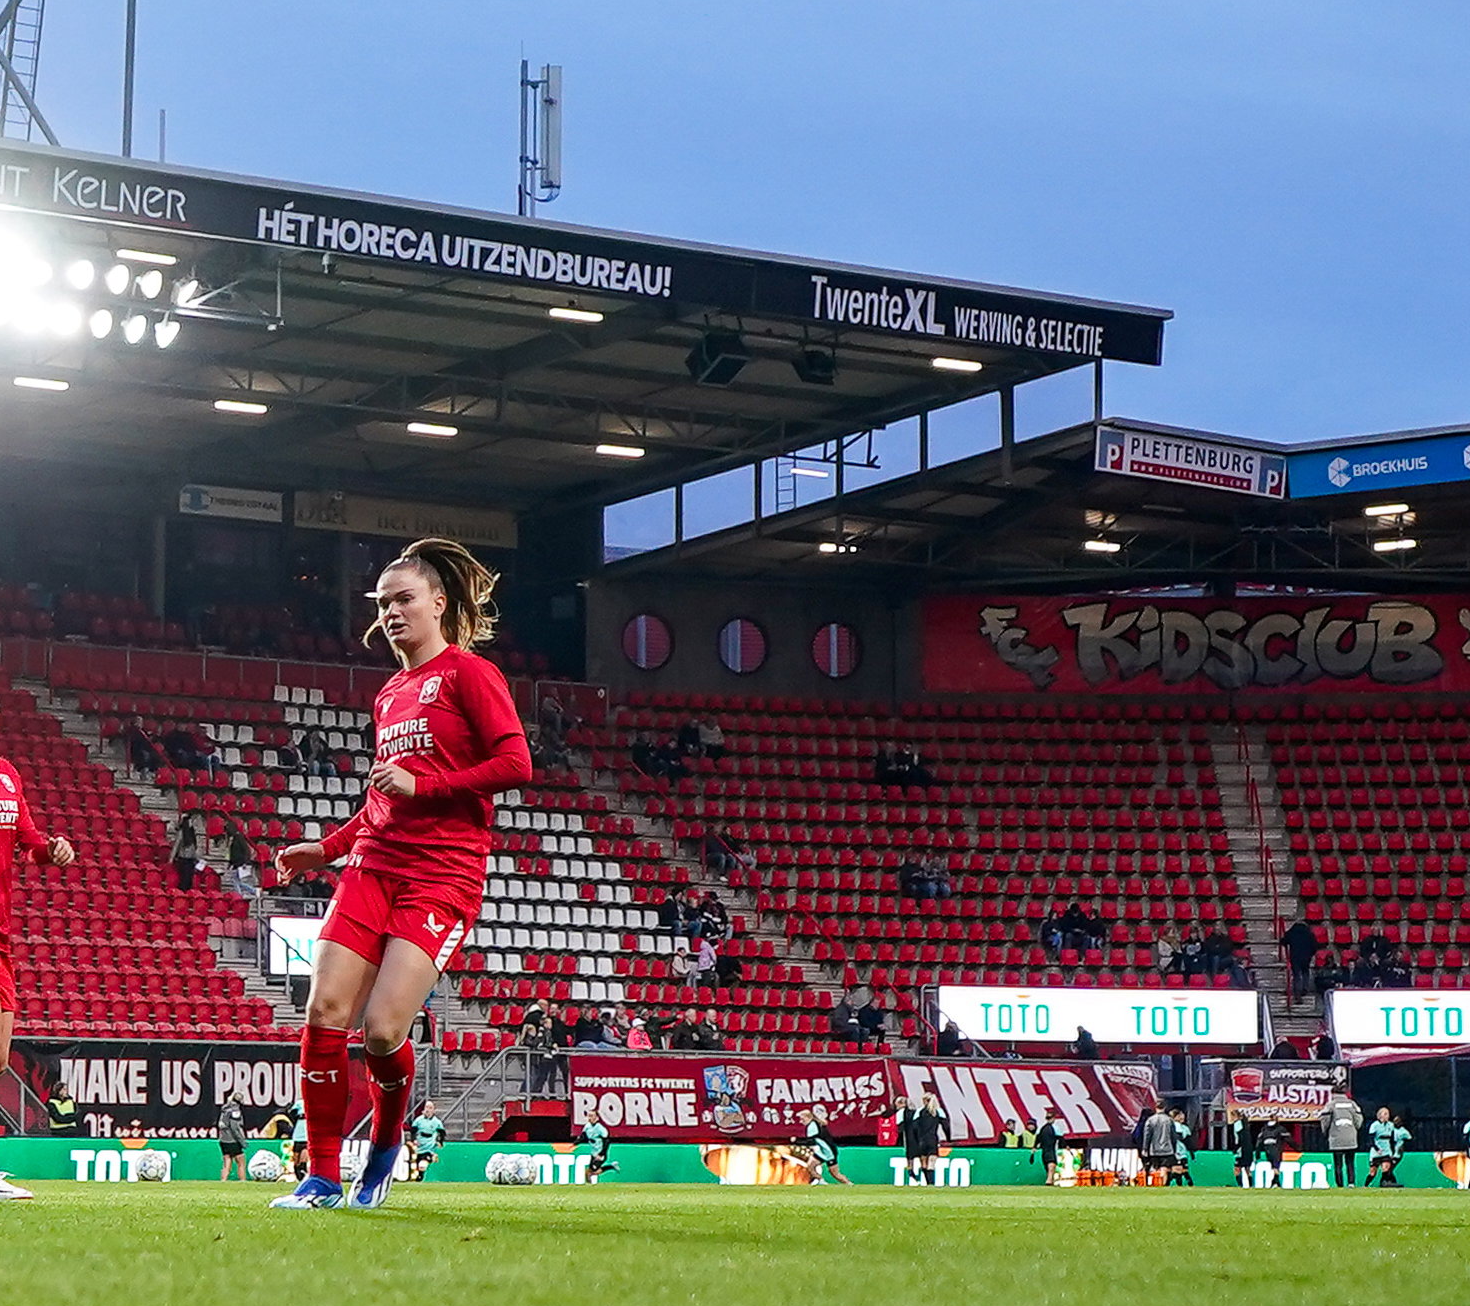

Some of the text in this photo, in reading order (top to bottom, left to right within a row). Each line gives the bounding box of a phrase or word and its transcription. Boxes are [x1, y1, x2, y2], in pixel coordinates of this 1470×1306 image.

[257, 200, 674, 298] HÉT HORECA UITZENDBUREAU!
[810, 273, 1104, 359] TwenteXL WERVING & SELECTIE
[1130, 437, 1254, 475] PLETTENBURG
[1352, 455, 1428, 479] BROEKHUIS
[378, 717, 429, 742] FUTURE
[980, 1002, 1050, 1035] TOTO
[1131, 1005, 1210, 1037] TOTO
[1380, 1006, 1463, 1038] TOTO
[60, 1058, 149, 1105] MAKE
[162, 1059, 202, 1106] US
[573, 1076, 696, 1090] SUPPORTERS FC TWENTE
[756, 1071, 885, 1105] FANATICS
[1269, 1069, 1328, 1080] SUPPORTERS
[572, 1091, 699, 1127] BORNE
[899, 1063, 1111, 1141] ENTER
